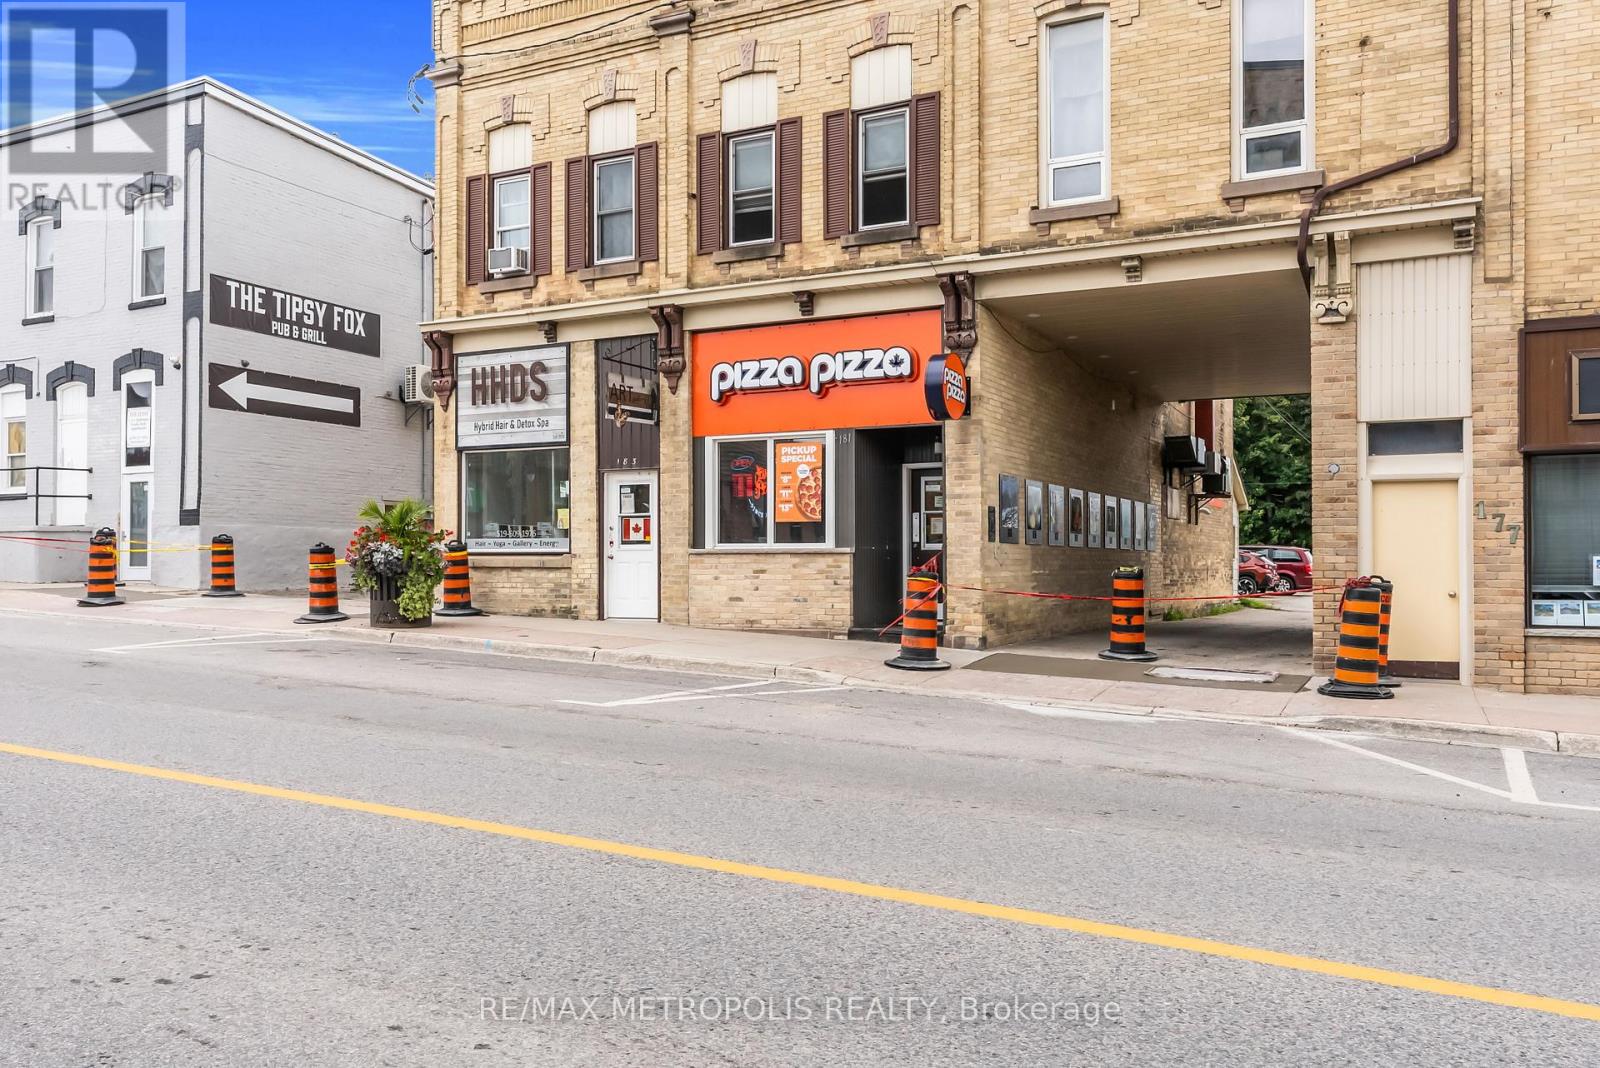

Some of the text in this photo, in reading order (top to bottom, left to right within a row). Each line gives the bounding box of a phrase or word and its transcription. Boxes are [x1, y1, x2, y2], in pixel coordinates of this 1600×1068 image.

[226, 280, 366, 337] THE TIPSY FOX
[271, 320, 328, 345] PUB & GRILL
[471, 361, 547, 406] HHDS
[610, 382, 634, 402] ART
[473, 417, 550, 434] Hybrid Hair & Detox Spa
[838, 433, 852, 445] 181
[781, 446, 818, 455] PICKUP
[781, 455, 818, 464] SPECIAL
[1473, 500, 1521, 545] 177
[474, 540, 487, 548] Hair
[493, 540, 507, 549] Yoga
[512, 540, 533, 549] Gallery
